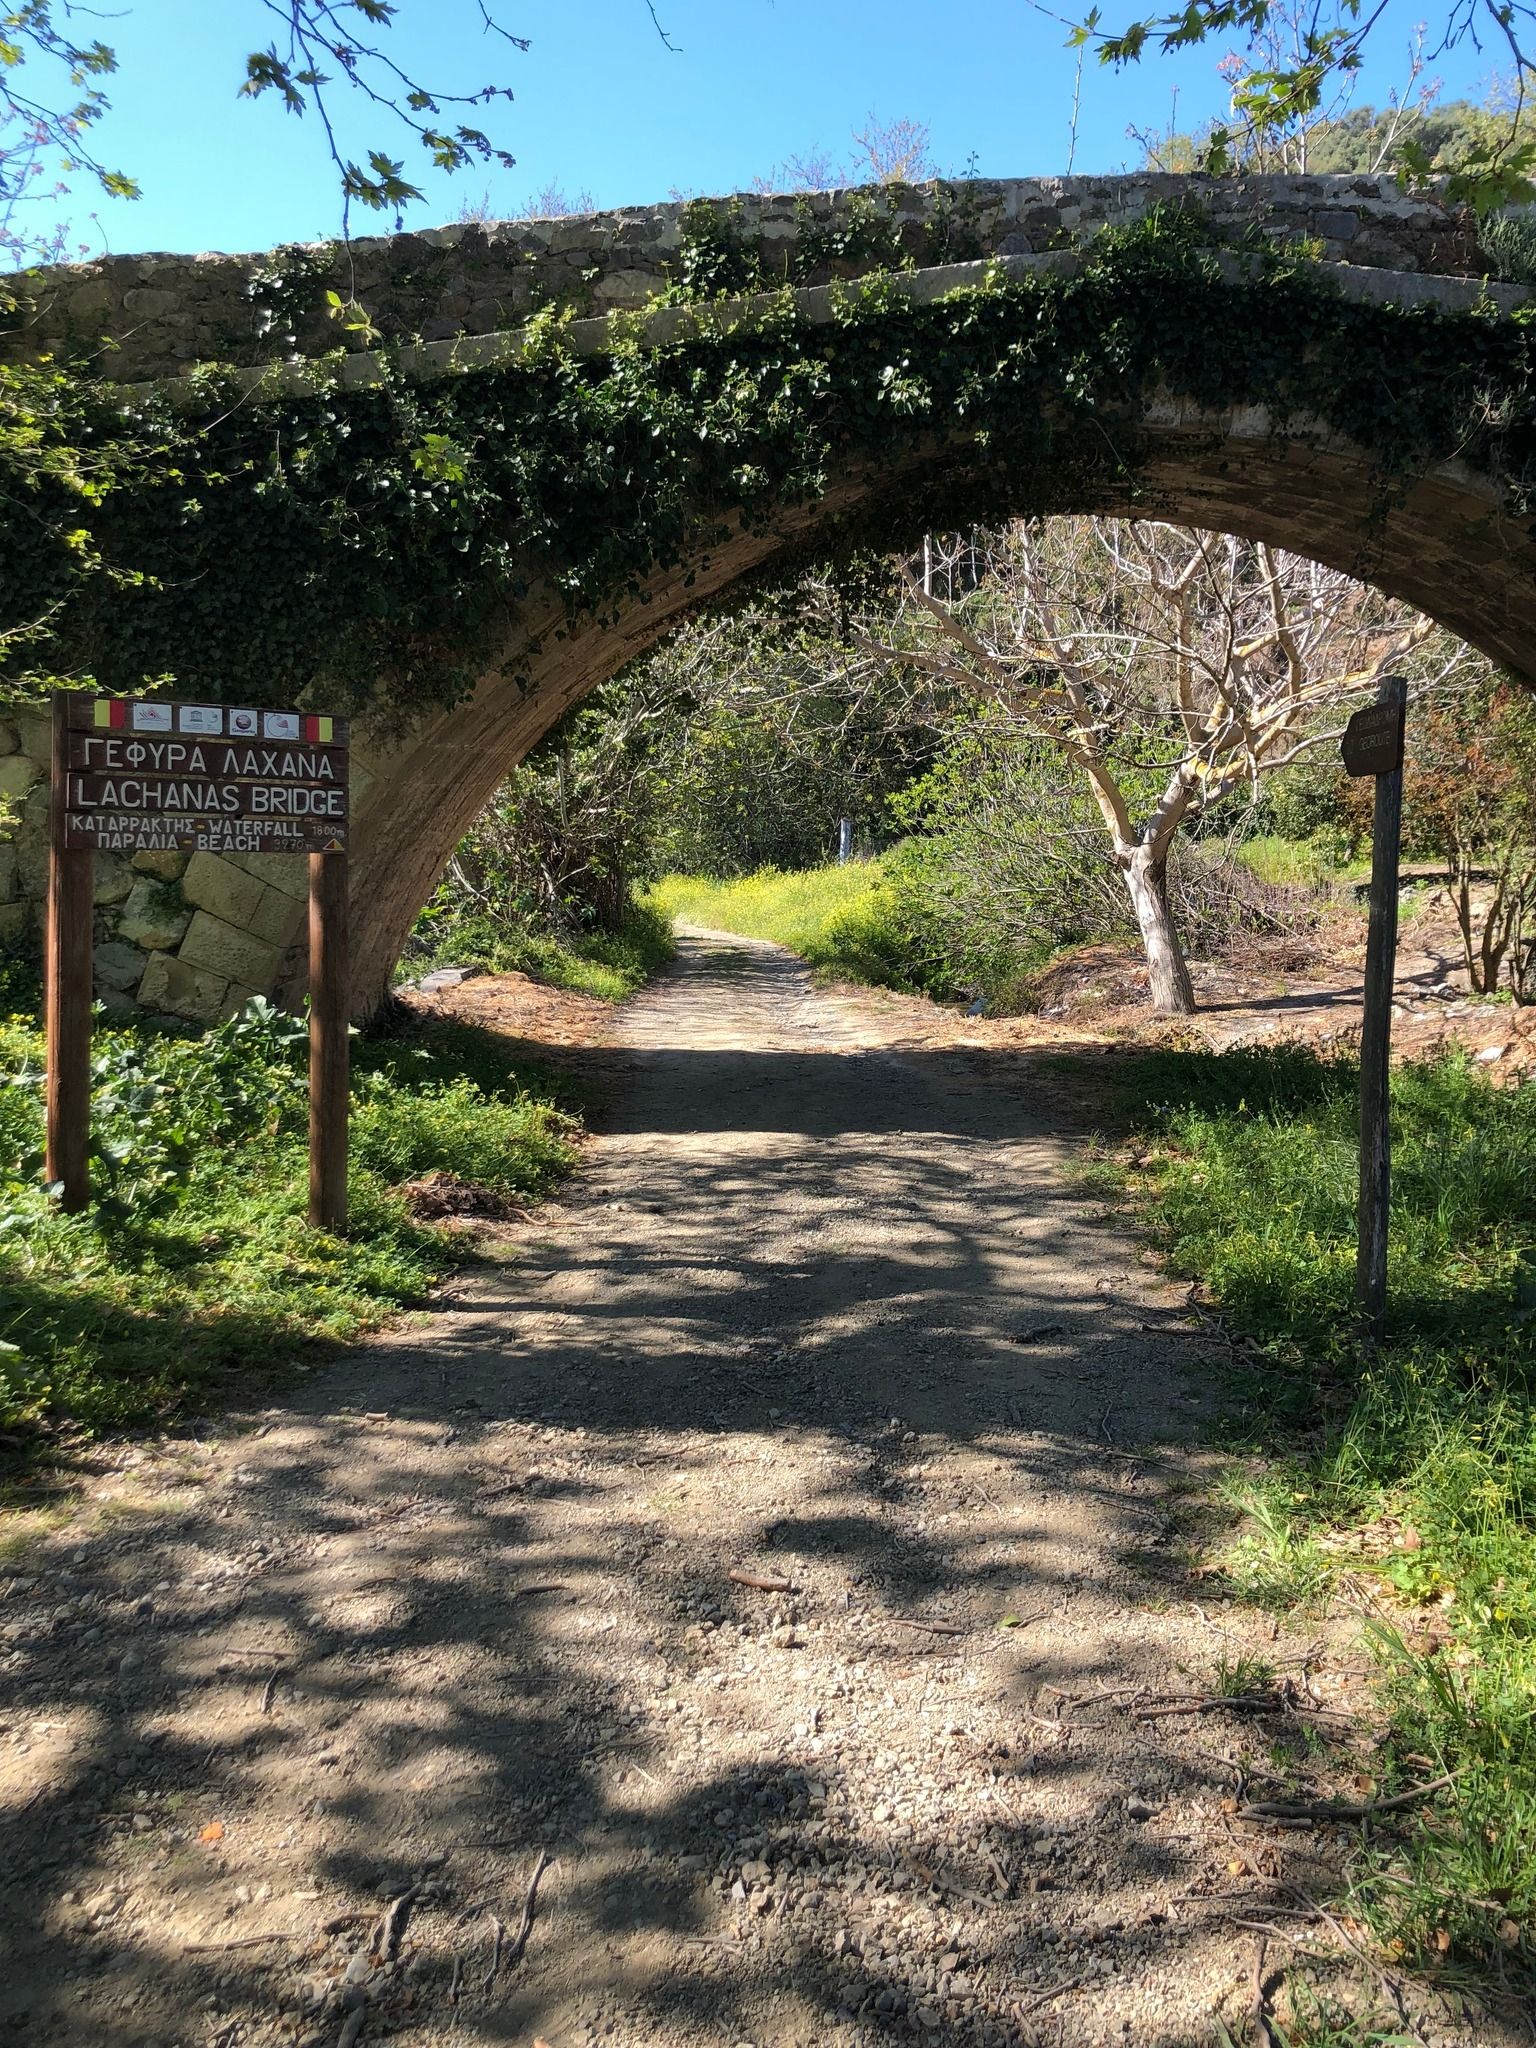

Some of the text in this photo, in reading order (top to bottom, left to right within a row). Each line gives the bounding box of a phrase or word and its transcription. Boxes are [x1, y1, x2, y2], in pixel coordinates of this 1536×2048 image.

[85, 738, 334, 779] ΓΕΦΥΡΑ ΛΑΧΑΝΑ
[78, 779, 344, 815] LACHANAS BRIDGE
[72, 815, 195, 833] ΚΑΤΑΡΡΑΚΤΗΣ
[209, 820, 304, 837] WATERFALL
[98, 832, 179, 849] ΠΑΡΑΛΙΑ
[198, 834, 259, 851] BEACH
